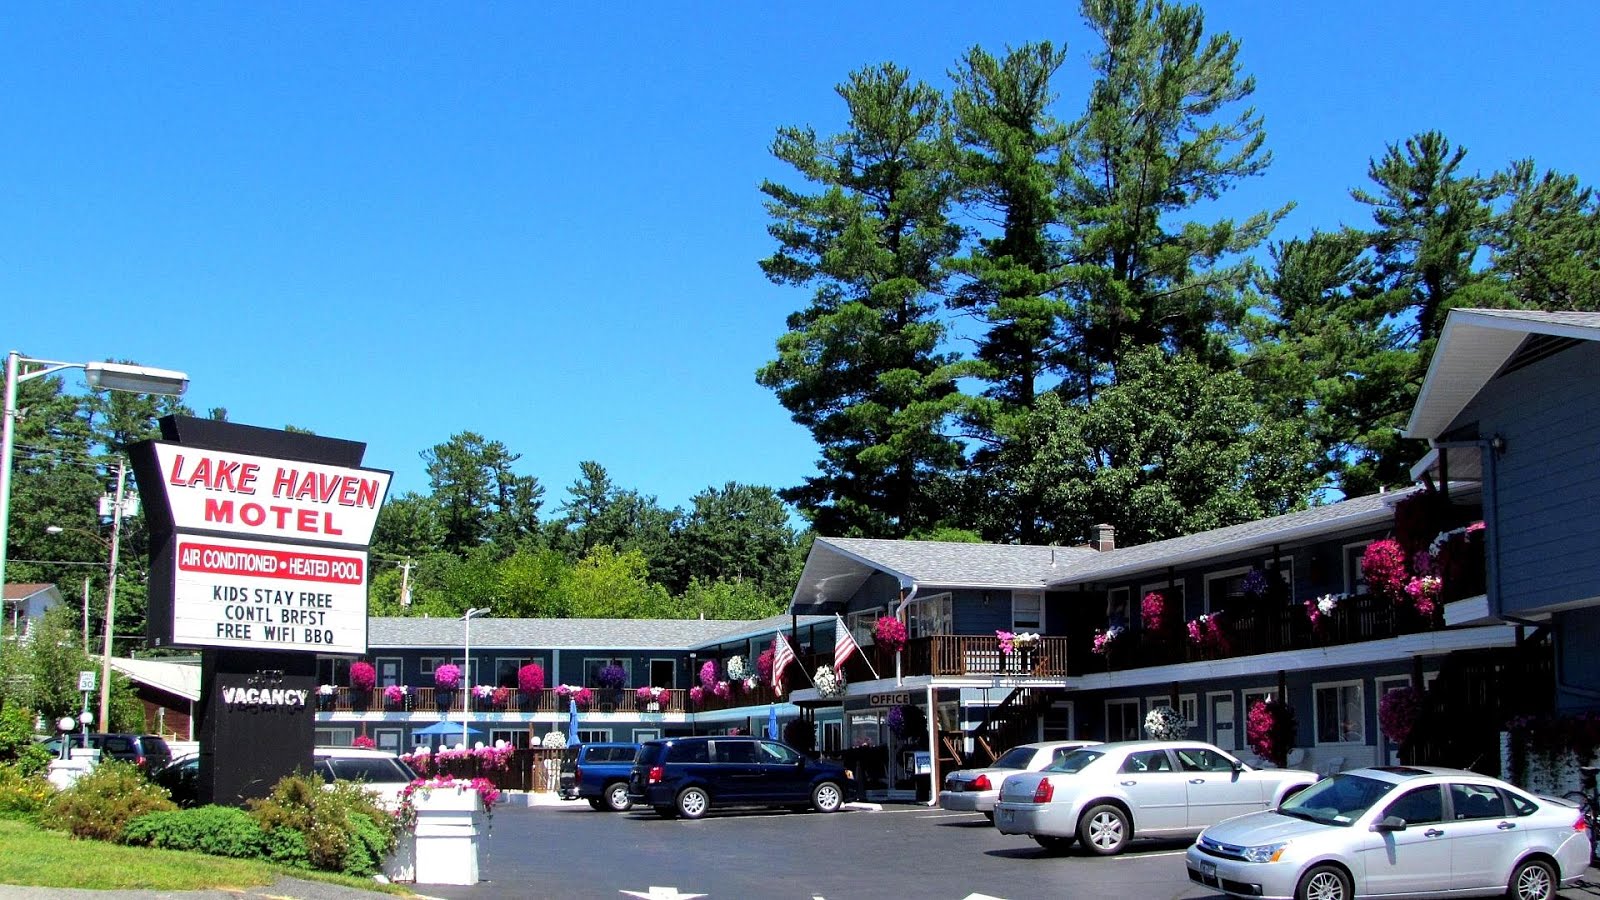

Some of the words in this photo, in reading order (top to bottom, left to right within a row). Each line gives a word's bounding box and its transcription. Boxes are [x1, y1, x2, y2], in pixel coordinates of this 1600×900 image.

[170, 454, 260, 495] LAKE
[272, 467, 380, 509] HAVEN
[204, 498, 343, 536] MOTEL
[182, 548, 201, 566] AIR
[203, 550, 278, 573] CONDITIONED
[289, 558, 330, 578] HEATED
[331, 562, 361, 580] POOL
[213, 585, 248, 602] KIDS
[254, 589, 294, 606] STAY
[300, 592, 333, 608] FREE
[225, 605, 273, 622] CONTL
[281, 609, 326, 626] BRFST
[216, 623, 251, 639] FREE
[264, 626, 295, 642] WIFI
[304, 629, 334, 644] BBQ
[81, 680, 93, 688] 30
[222, 686, 309, 706] VACANCY
[871, 694, 909, 704] OFFICE
